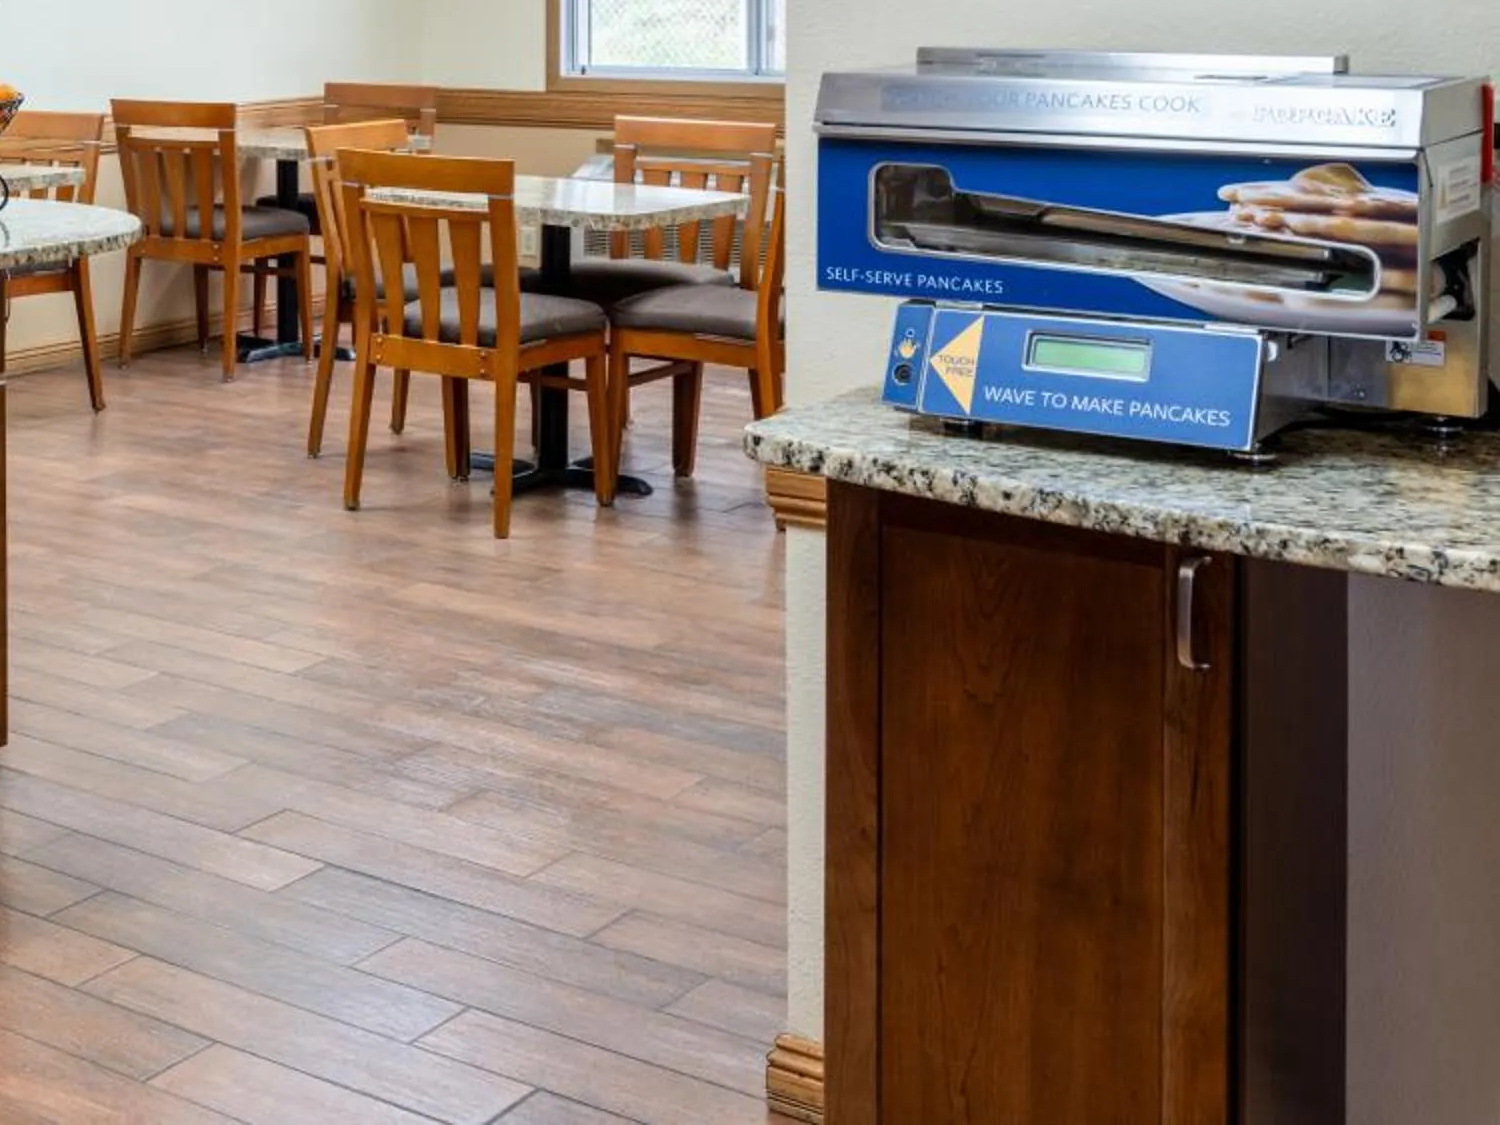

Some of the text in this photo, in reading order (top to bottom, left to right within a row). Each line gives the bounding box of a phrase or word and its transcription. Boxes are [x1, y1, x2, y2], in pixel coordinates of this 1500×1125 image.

[1025, 90, 1131, 110] PANCAKES
[1138, 94, 1202, 113] COOK
[825, 266, 1004, 294] SELF-SERVE PANCAKES
[984, 386, 1231, 427] WAVE TO MAKE PANCAKES
